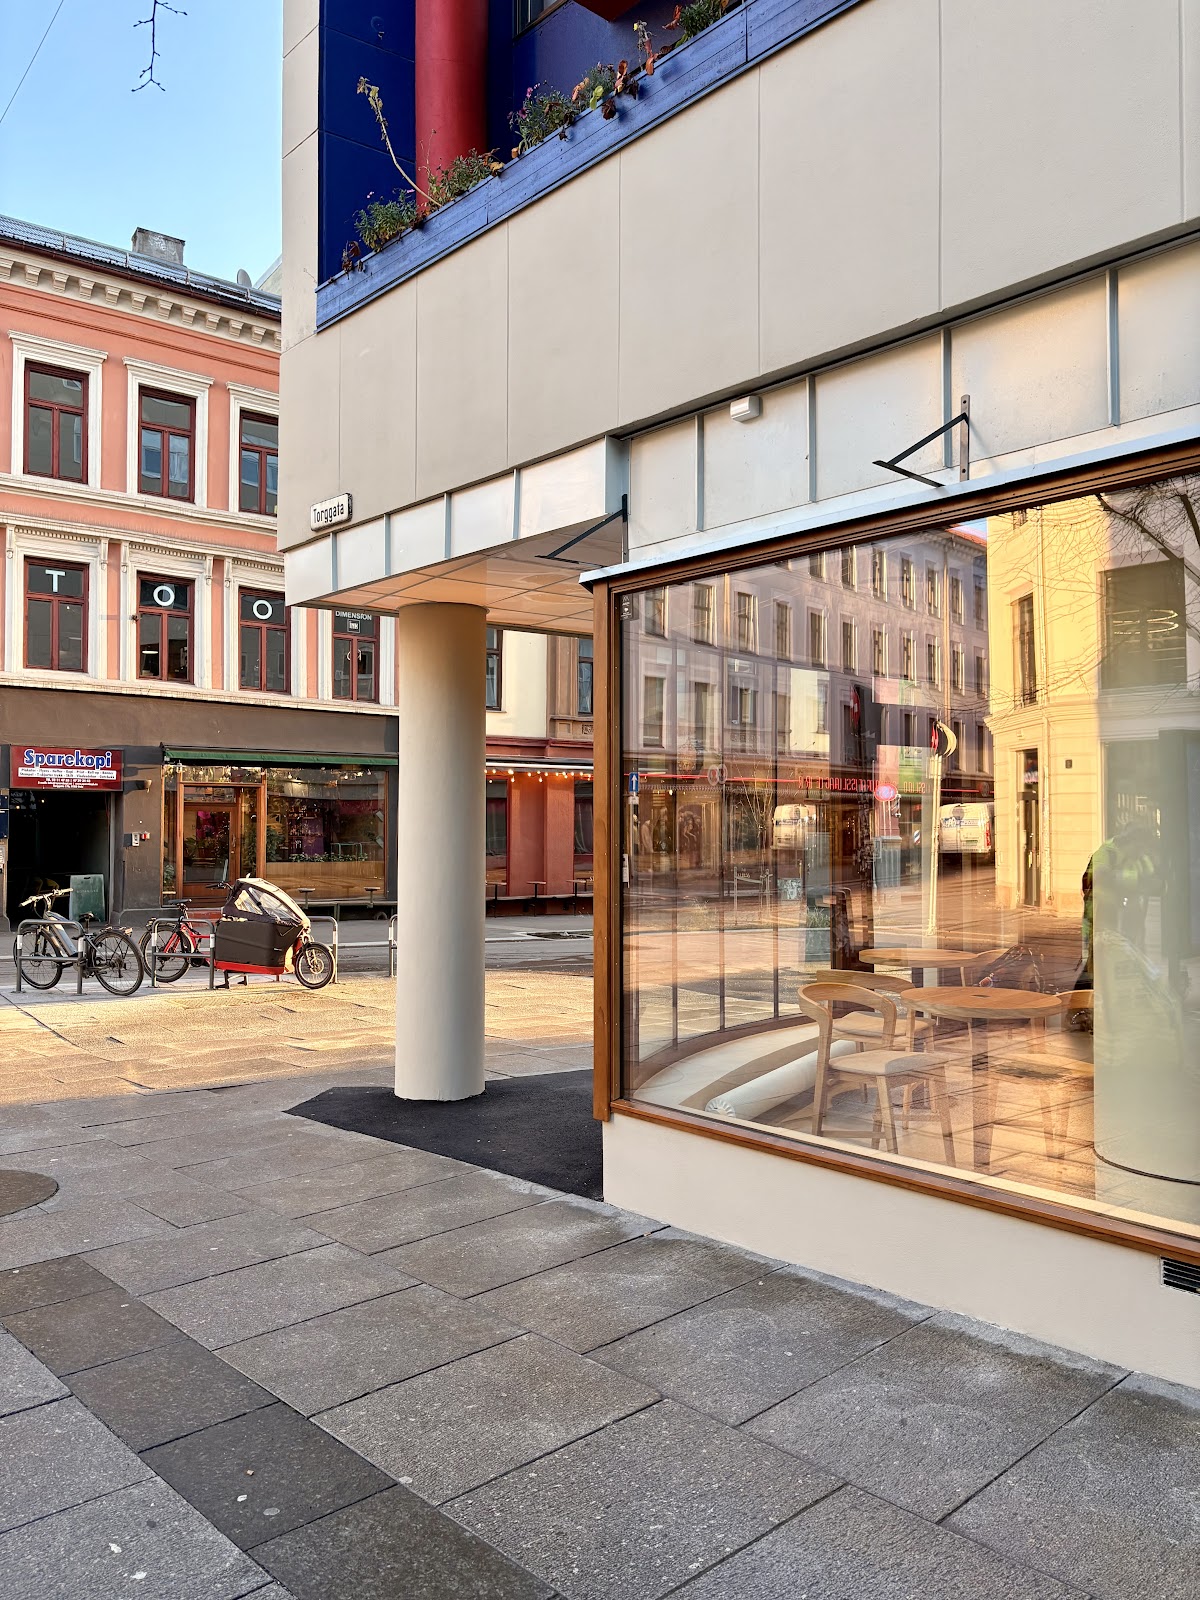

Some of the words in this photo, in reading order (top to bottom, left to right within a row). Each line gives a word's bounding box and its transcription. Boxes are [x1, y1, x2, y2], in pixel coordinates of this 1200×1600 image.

[313, 501, 344, 523] Torggata
[45, 569, 66, 593] T
[153, 585, 175, 607] O
[252, 599, 273, 620] O
[335, 610, 372, 621] DIMENSION
[24, 749, 112, 770] Sparekopi
